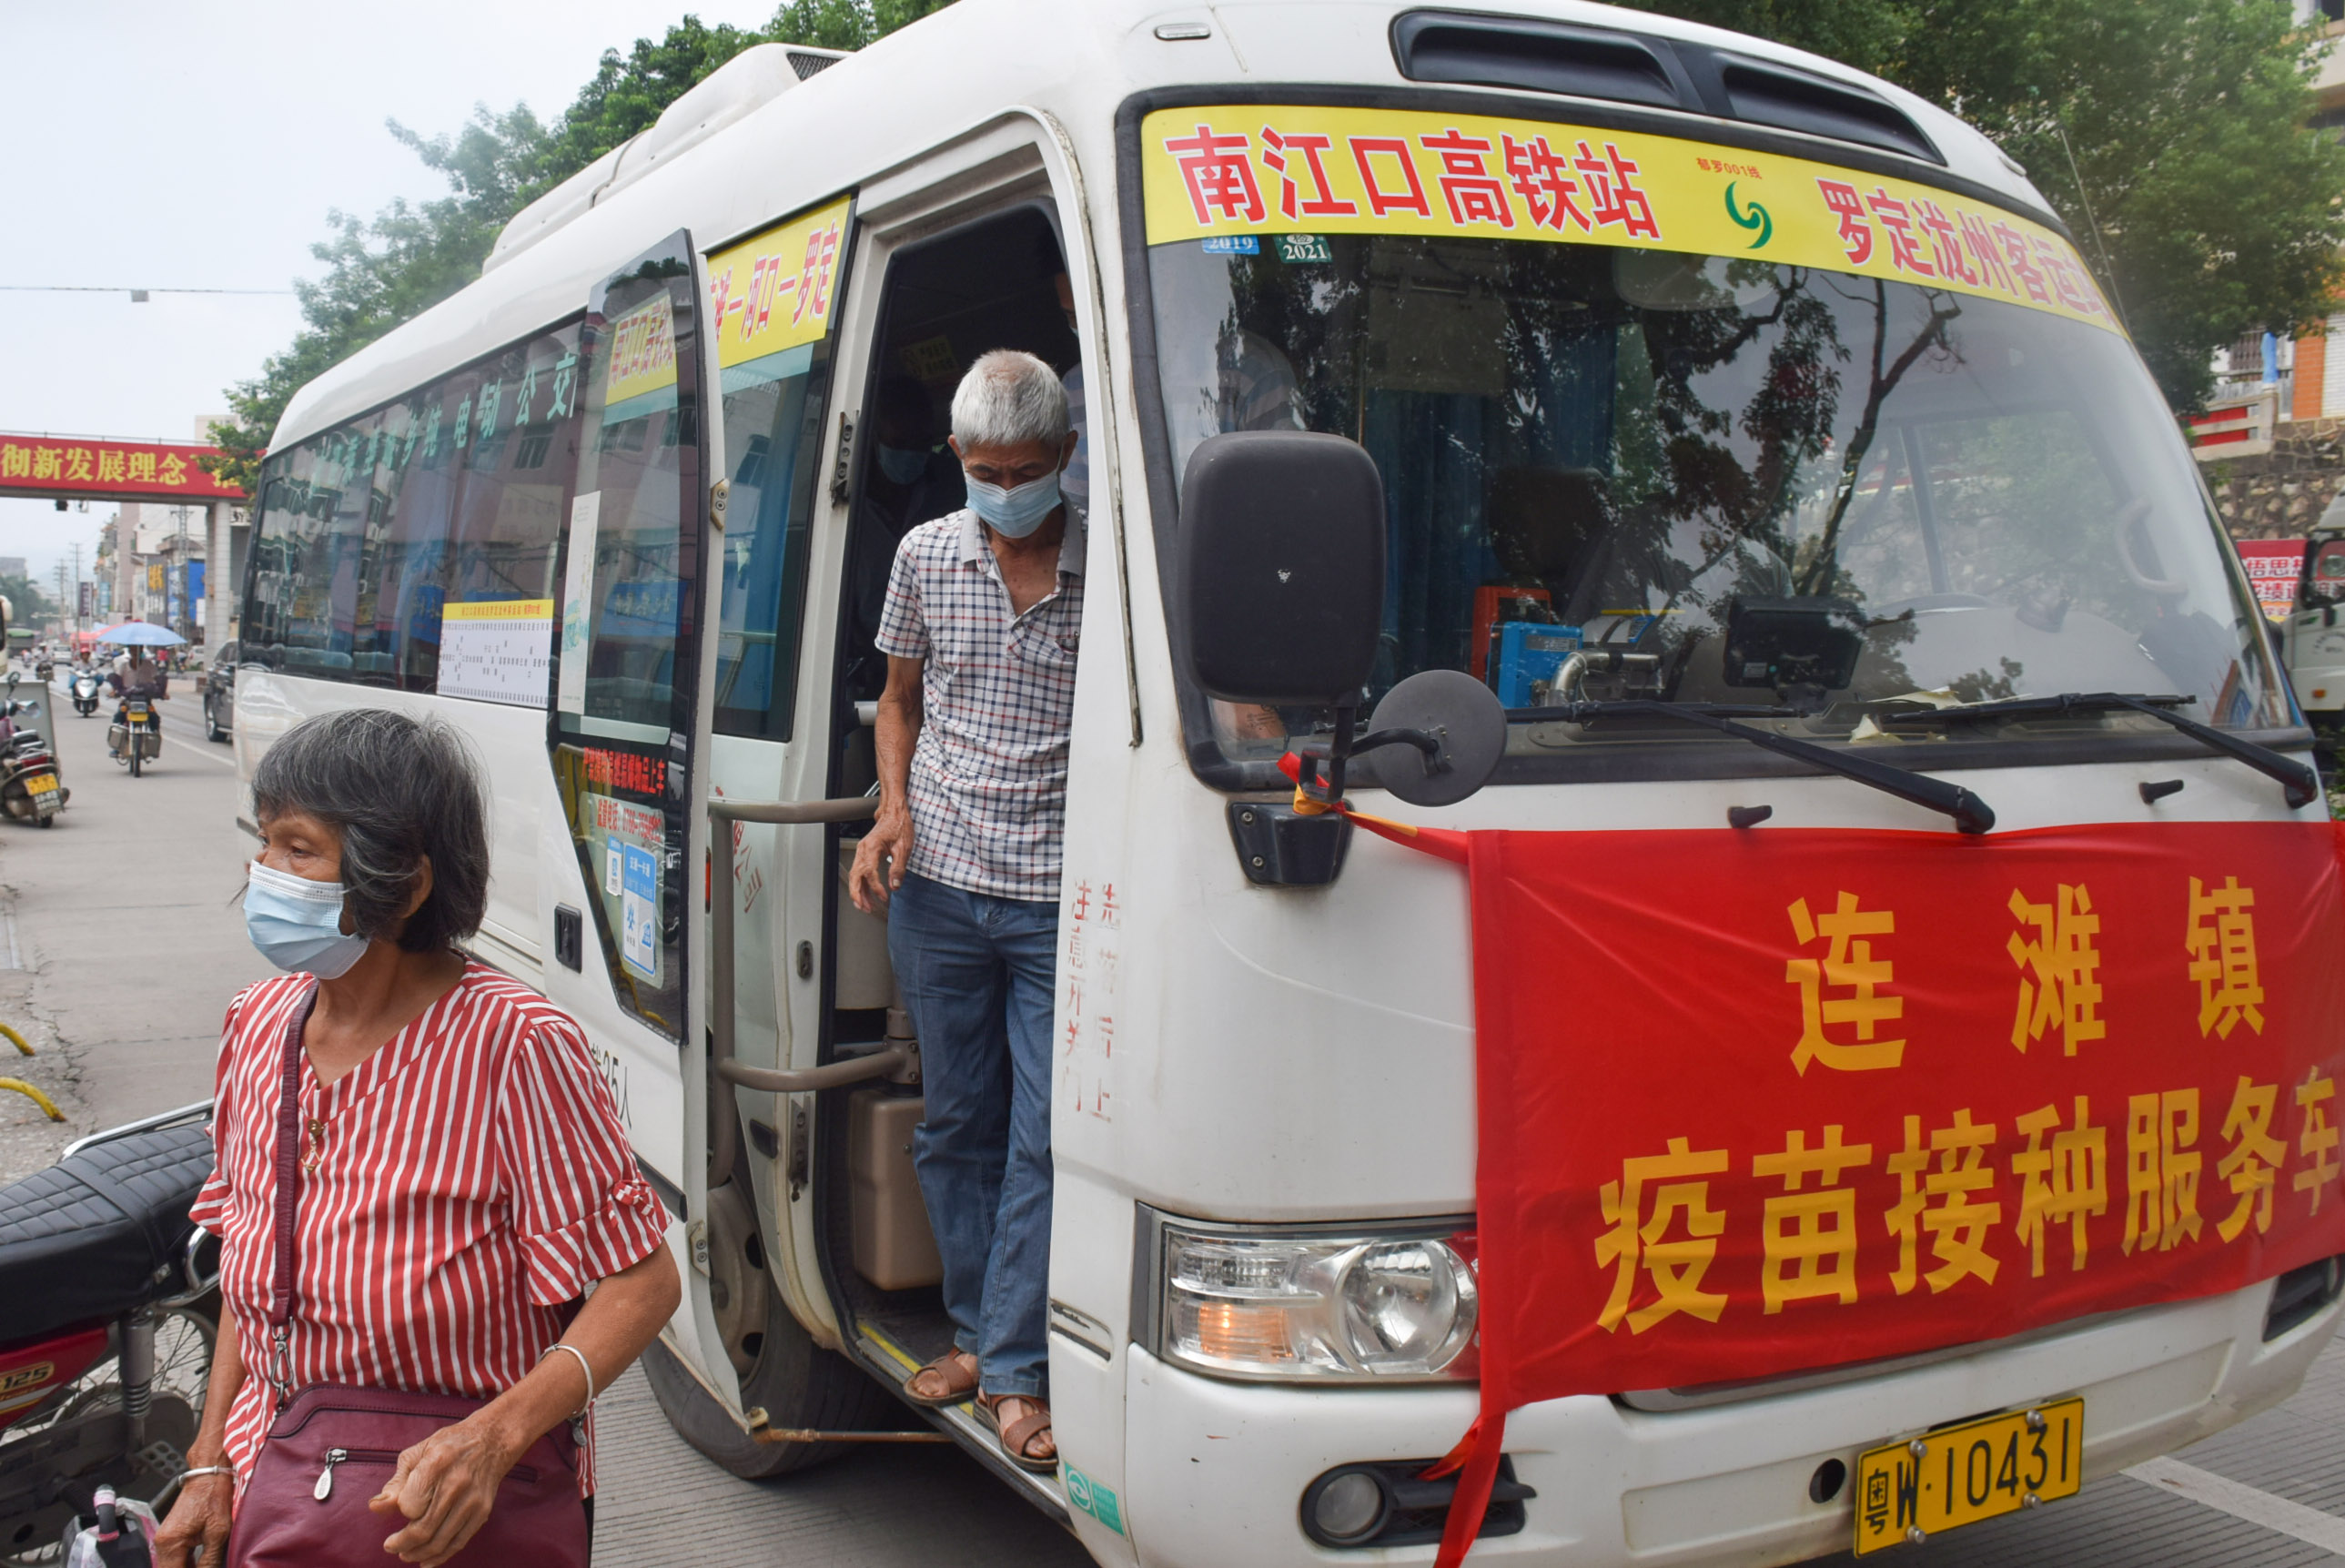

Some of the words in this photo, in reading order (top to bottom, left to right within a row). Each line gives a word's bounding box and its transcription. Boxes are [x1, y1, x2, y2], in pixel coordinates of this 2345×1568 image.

[1164, 124, 1663, 241] 南江口高铁站
[1208, 236, 1254, 250] 2019
[1283, 244, 1328, 260] 2021
[1785, 875, 2265, 1077] 连滩镇
[1595, 1064, 2342, 1335] 疫苗接种服务车
[4, 1365, 49, 1390] 125
